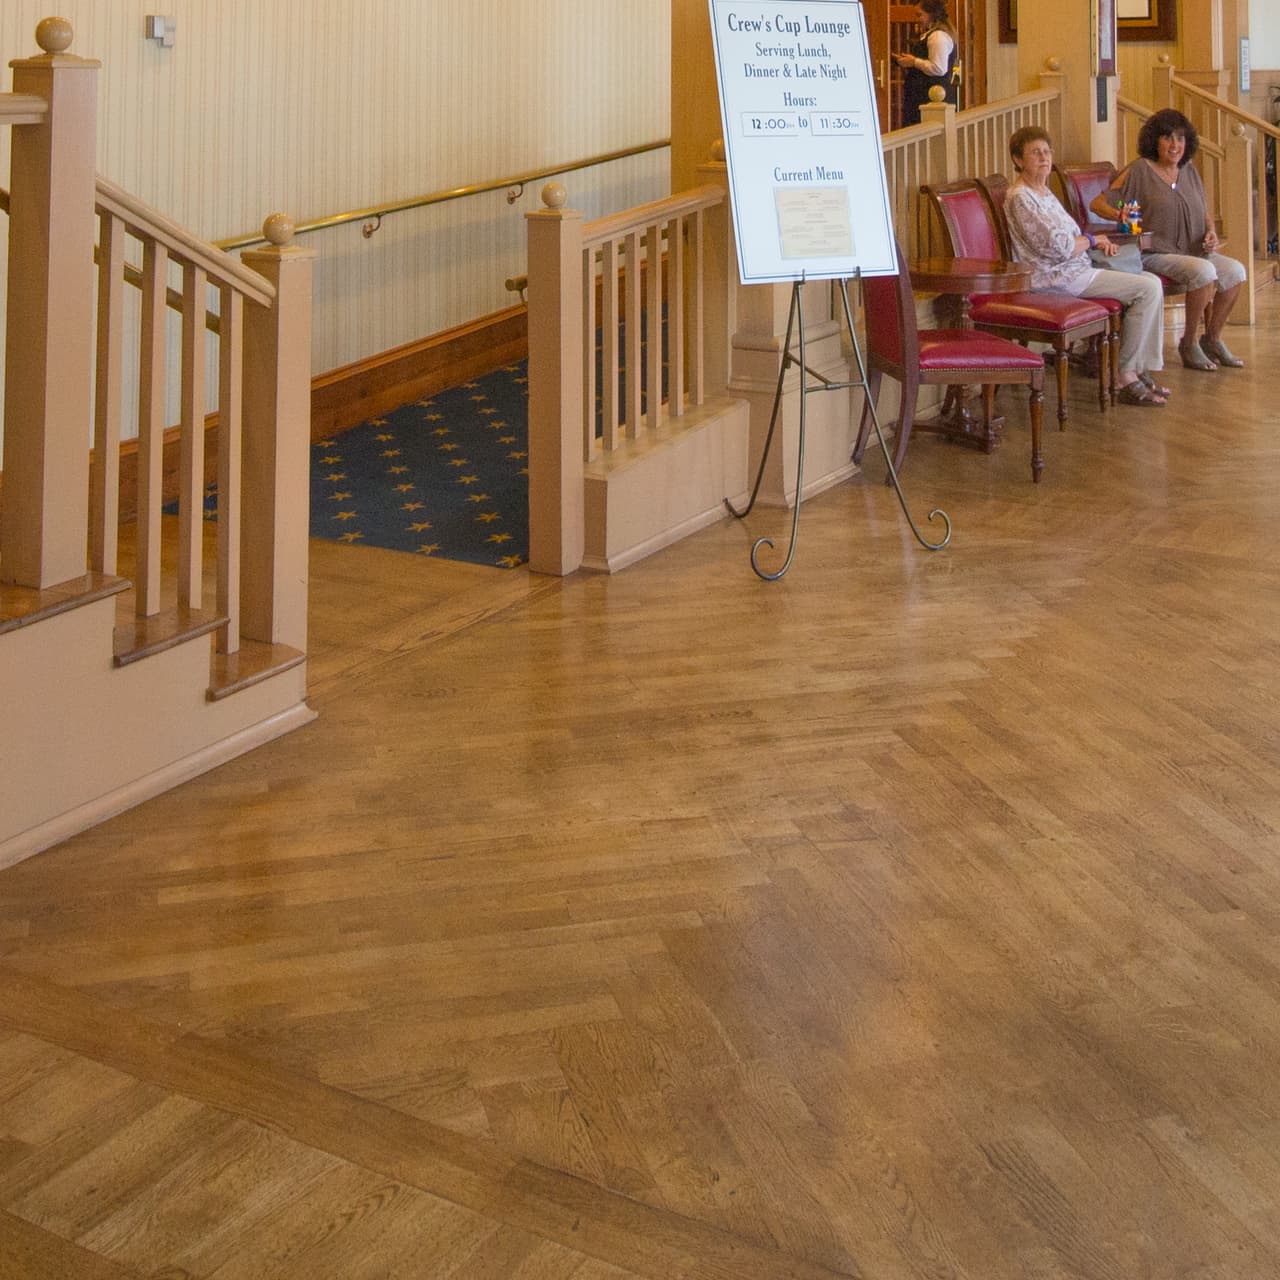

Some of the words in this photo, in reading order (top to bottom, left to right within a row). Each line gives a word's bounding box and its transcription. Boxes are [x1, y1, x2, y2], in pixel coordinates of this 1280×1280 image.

[728, 13, 772, 33] Crew's
[775, 14, 801, 37] Cup
[805, 15, 851, 37] Lounge
[755, 42, 795, 60] Serving
[797, 43, 832, 58] Lunch,
[744, 63, 780, 78] Dinner
[782, 63, 793, 78] &
[795, 64, 818, 78] Late
[819, 64, 847, 81] Night
[783, 92, 818, 107] Hours:
[798, 116, 808, 128] to
[773, 168, 814, 183] Current
[815, 167, 844, 181] Menu
